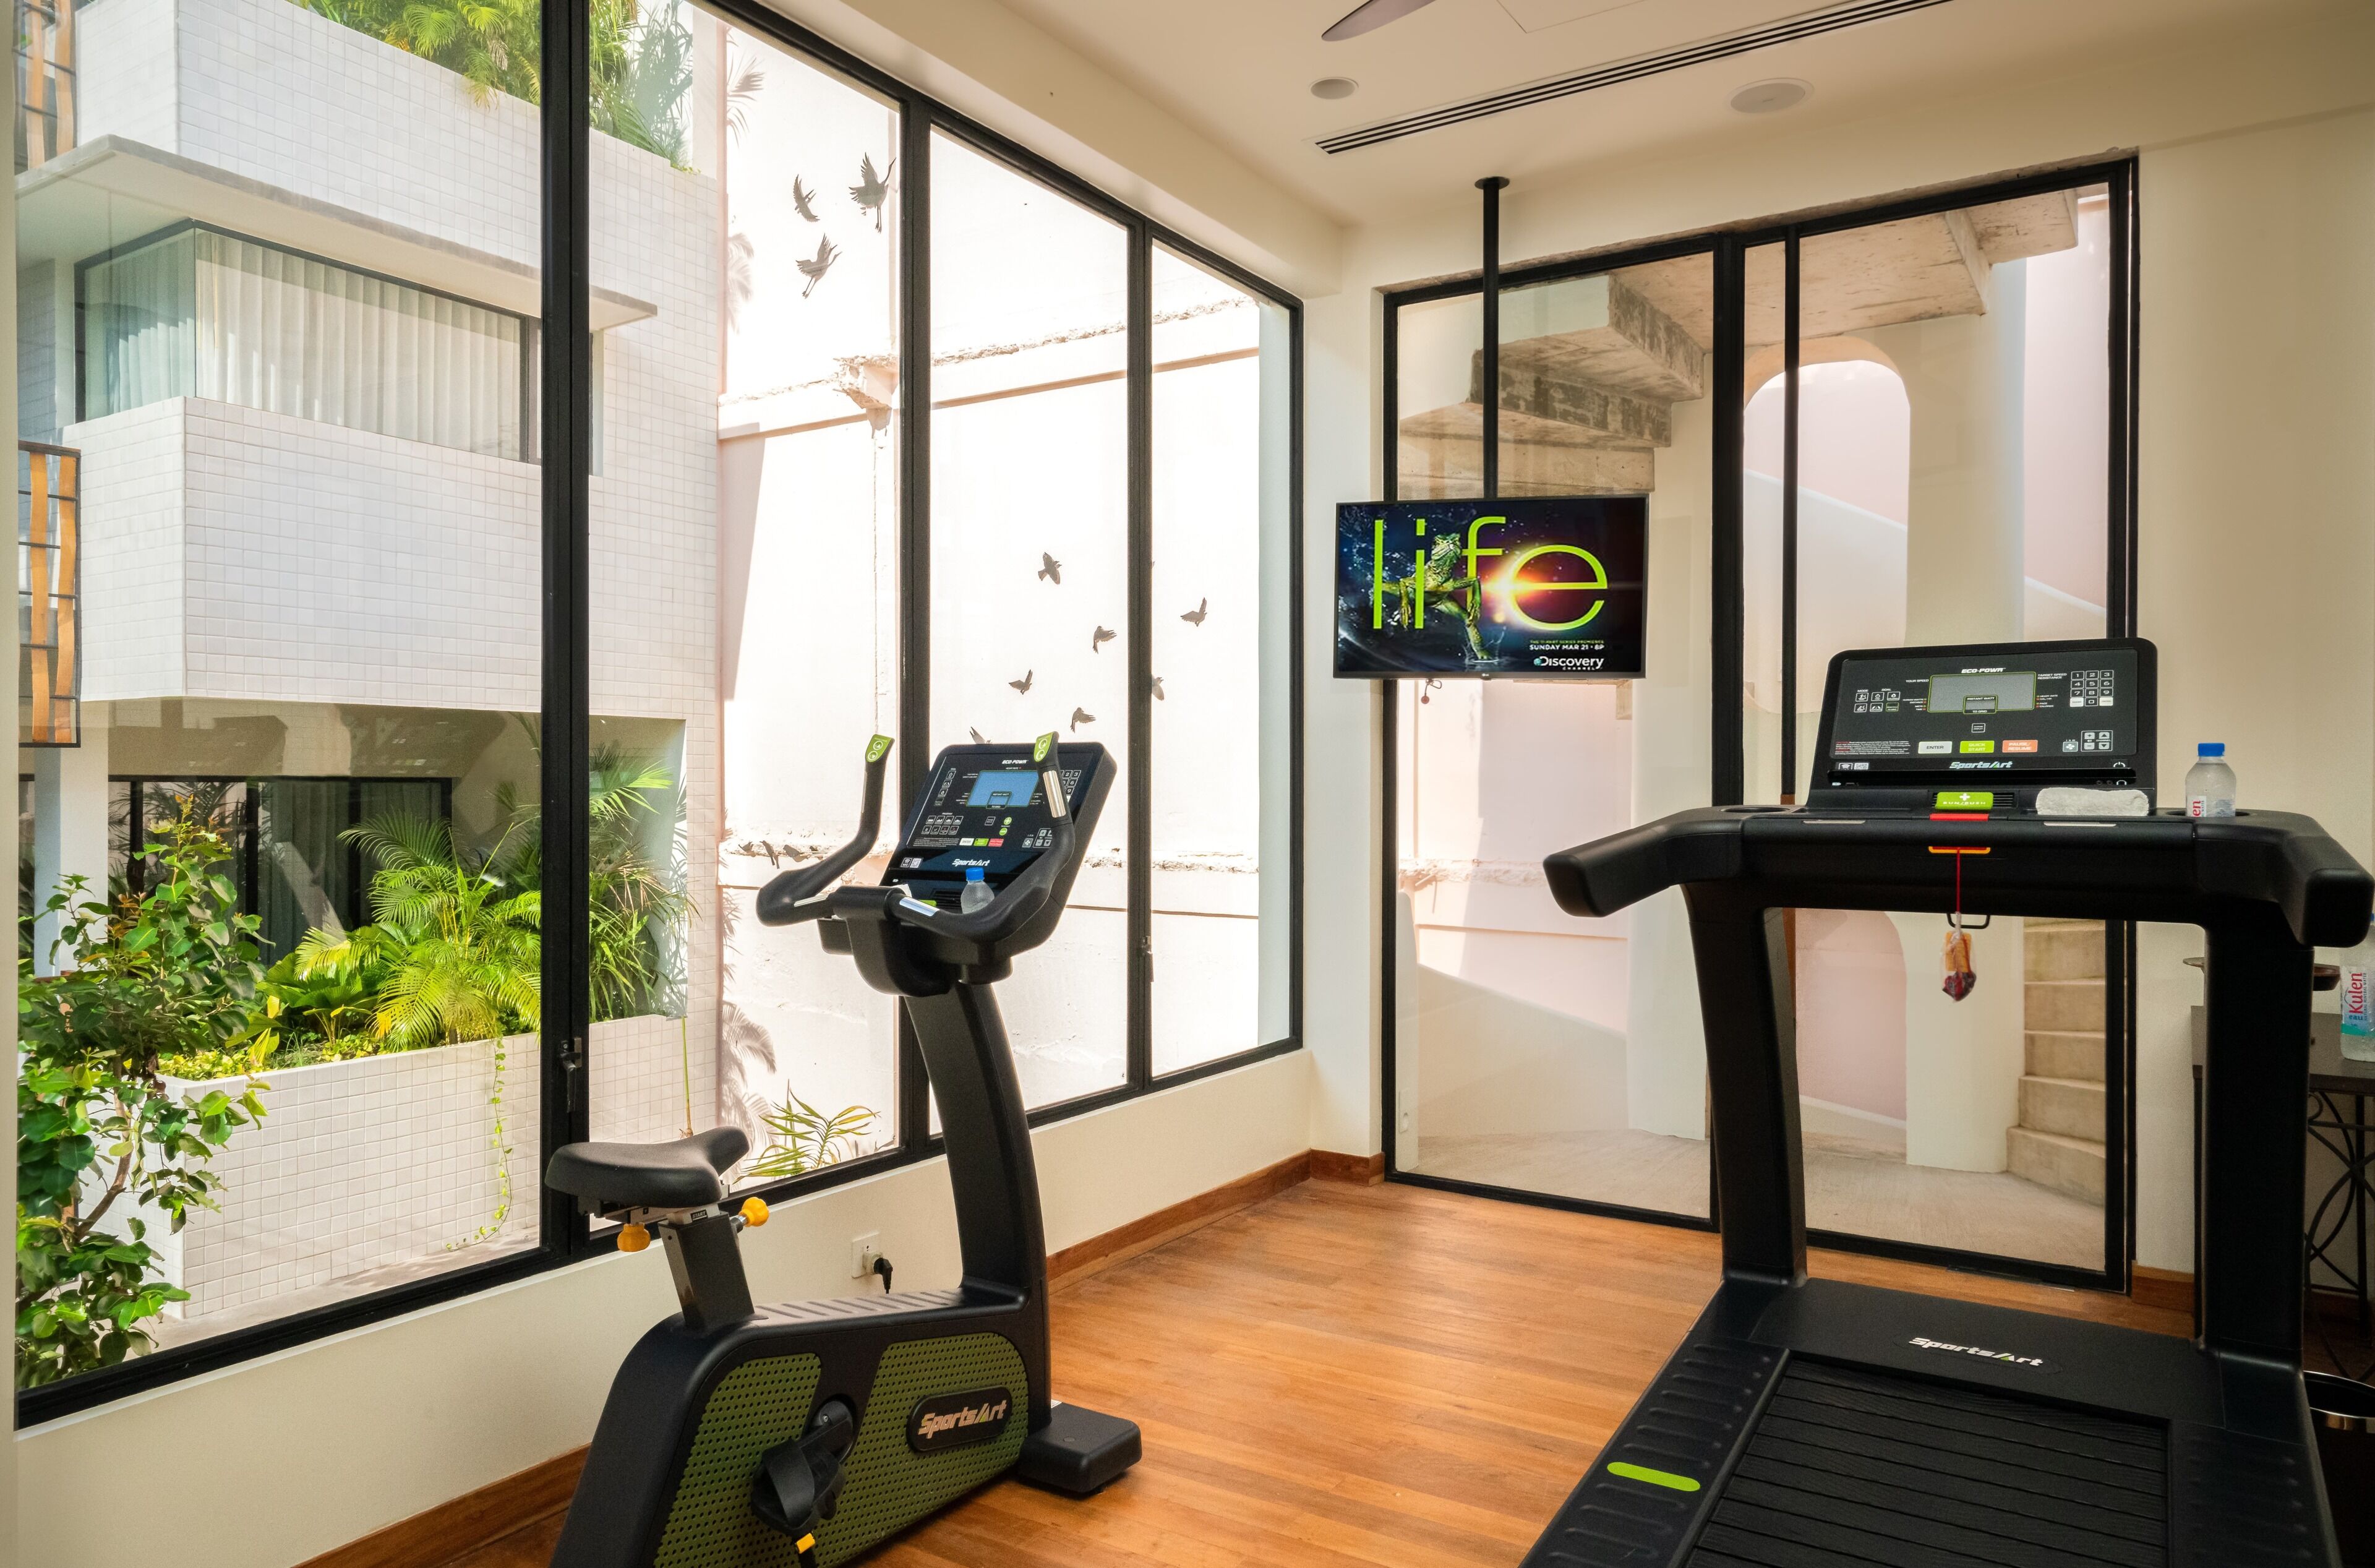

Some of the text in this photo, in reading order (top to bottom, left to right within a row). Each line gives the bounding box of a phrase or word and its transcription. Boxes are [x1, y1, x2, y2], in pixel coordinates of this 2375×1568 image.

[1372, 516, 1608, 632] life
[1949, 761, 2013, 769] SportsArt
[952, 859, 990, 867] SportsArt
[2348, 972, 2363, 1014] Kulen
[1908, 1337, 2043, 1366] SportsArt
[918, 1400, 1007, 1439] SportsArt
